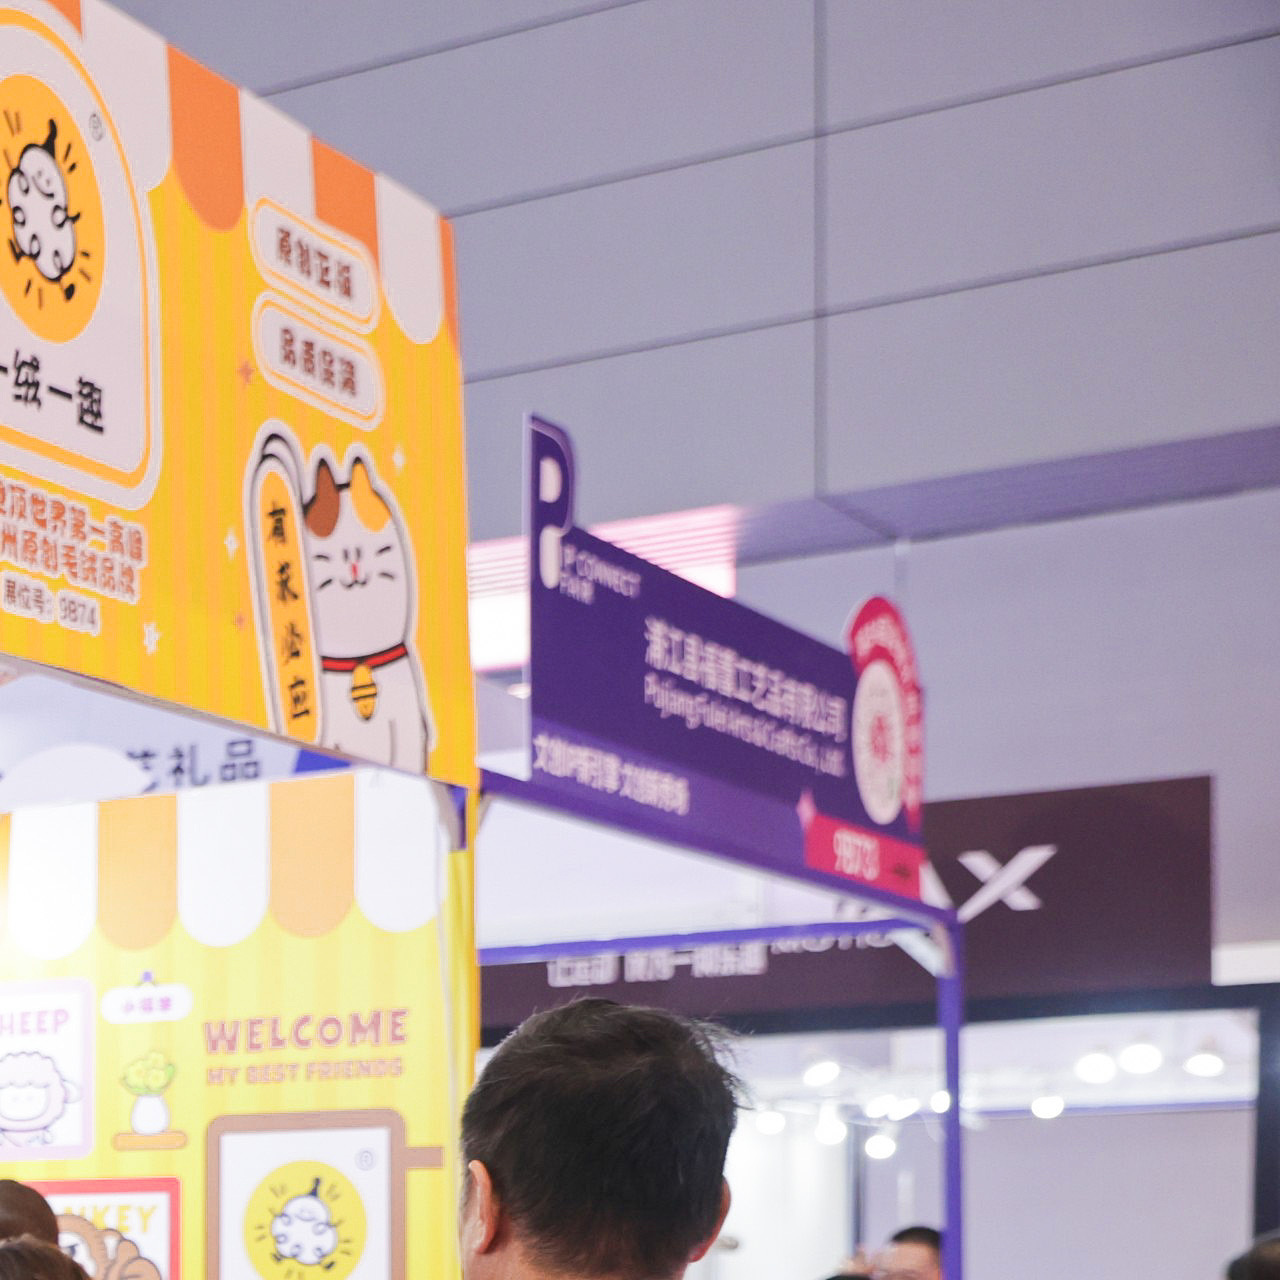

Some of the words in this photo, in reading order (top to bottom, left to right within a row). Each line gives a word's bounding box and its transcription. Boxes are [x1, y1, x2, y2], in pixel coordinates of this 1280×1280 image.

[203, 1008, 409, 1053] WELCOME
[207, 1066, 237, 1086] MY
[248, 1062, 300, 1084] BEST
[305, 1057, 404, 1082] FRIENDS
